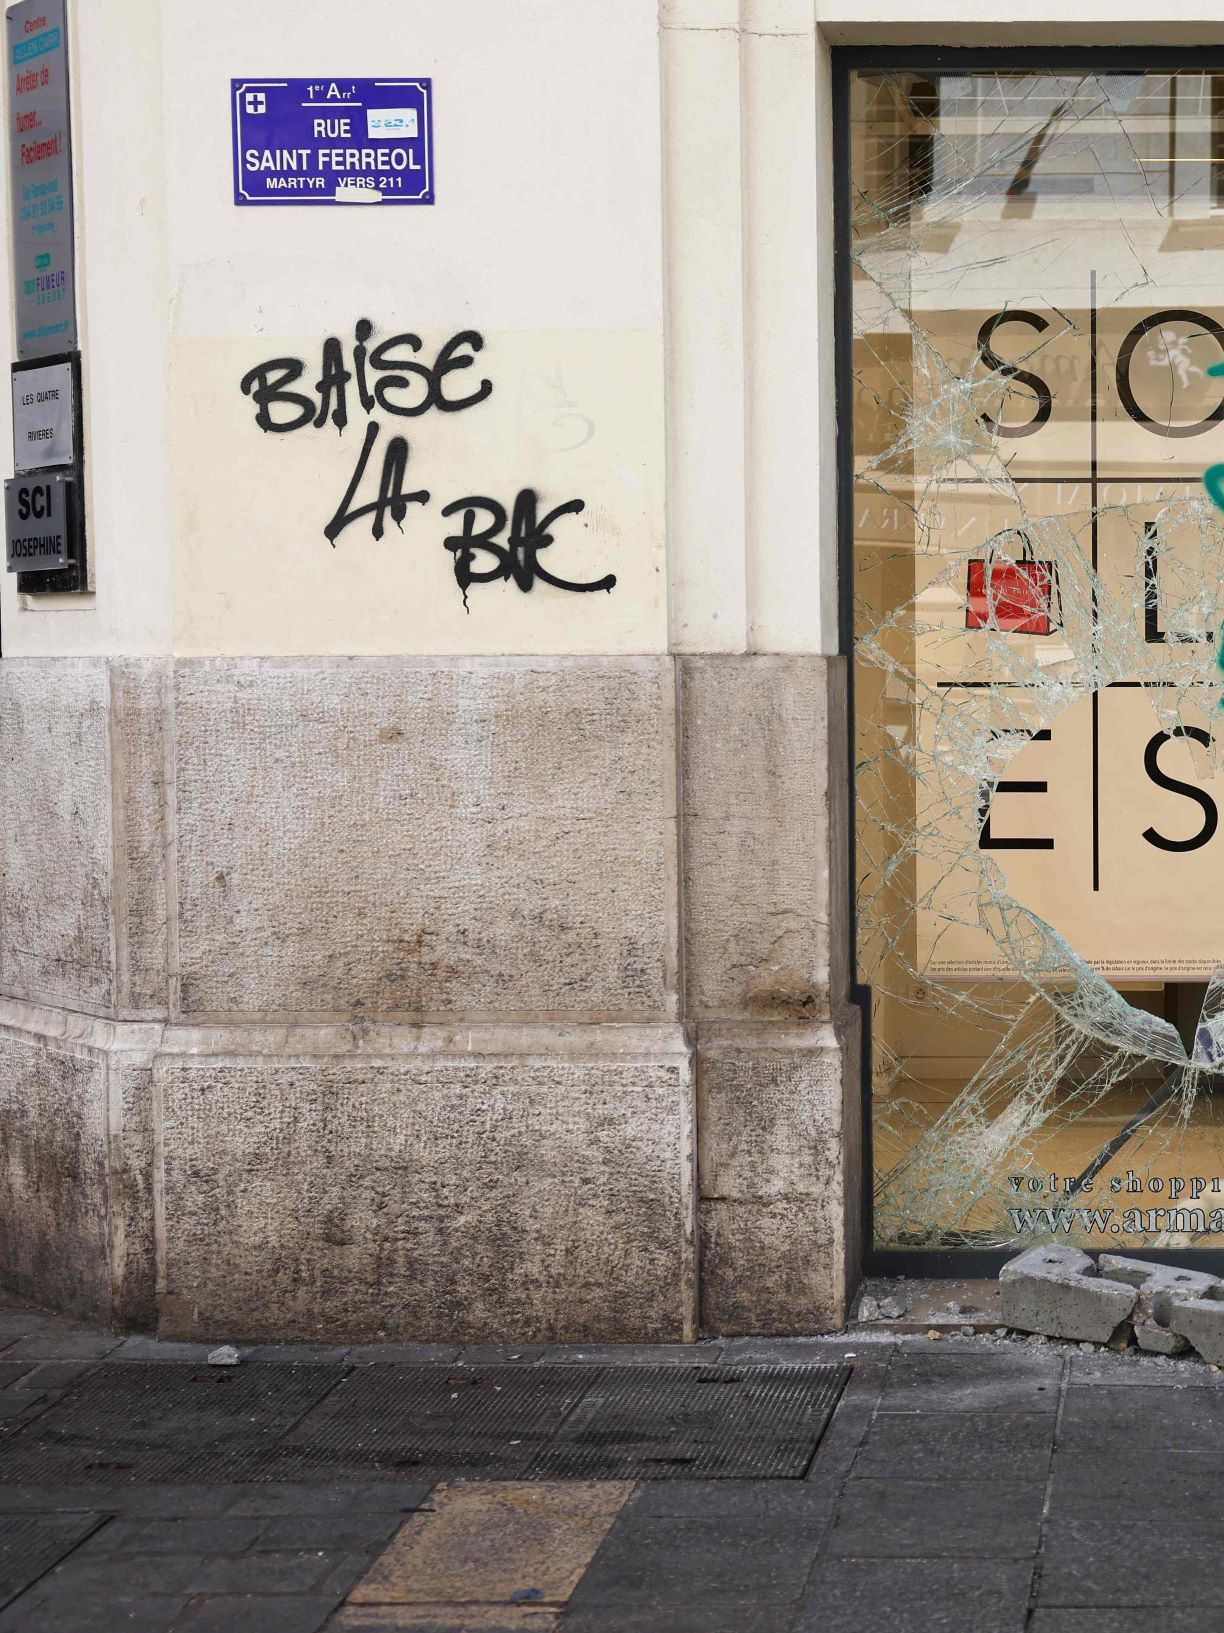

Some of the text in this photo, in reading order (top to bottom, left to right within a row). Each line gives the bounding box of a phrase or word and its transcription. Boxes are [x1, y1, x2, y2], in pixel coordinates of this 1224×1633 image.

[40, 64, 49, 87] de
[313, 118, 352, 138] RUE
[245, 148, 422, 171] SAINT FERREOL
[266, 177, 402, 189] MARTYR VERS 211
[36, 270, 65, 292] FUMEUR
[22, 388, 60, 406] LES QUATRE
[27, 427, 54, 442] RIVIERES
[324, 421, 431, 547] LA
[18, 485, 53, 521] SCI
[10, 534, 62, 559] JOSEPHINE
[1008, 1172, 1095, 1193] votre
